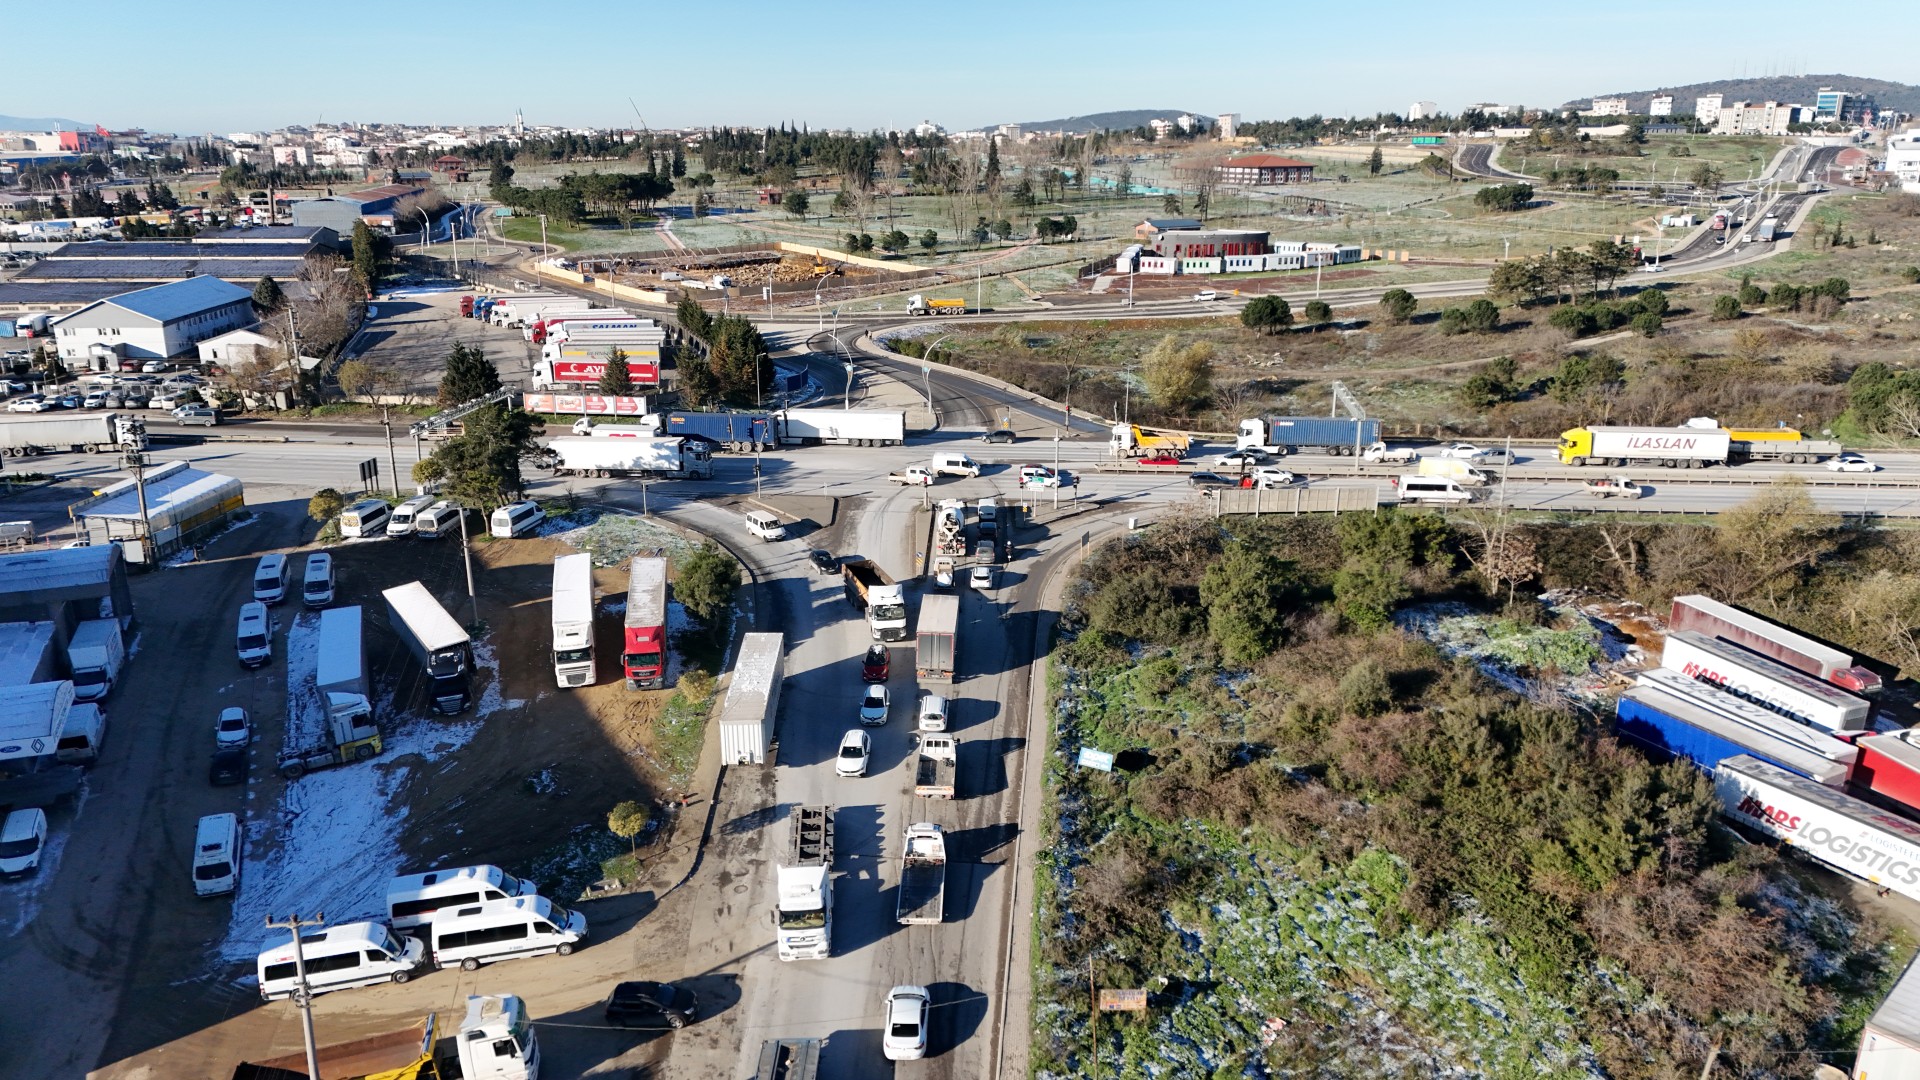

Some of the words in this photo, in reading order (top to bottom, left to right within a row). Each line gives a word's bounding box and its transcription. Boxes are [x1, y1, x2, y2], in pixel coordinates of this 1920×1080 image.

[1627, 434, 1697, 449] İLASLAN
[1681, 661, 1728, 689] MARS
[1724, 680, 1815, 726] LOGISTICS
[1737, 796, 1802, 831] MARS
[1797, 822, 1920, 885] LOGISTICS
